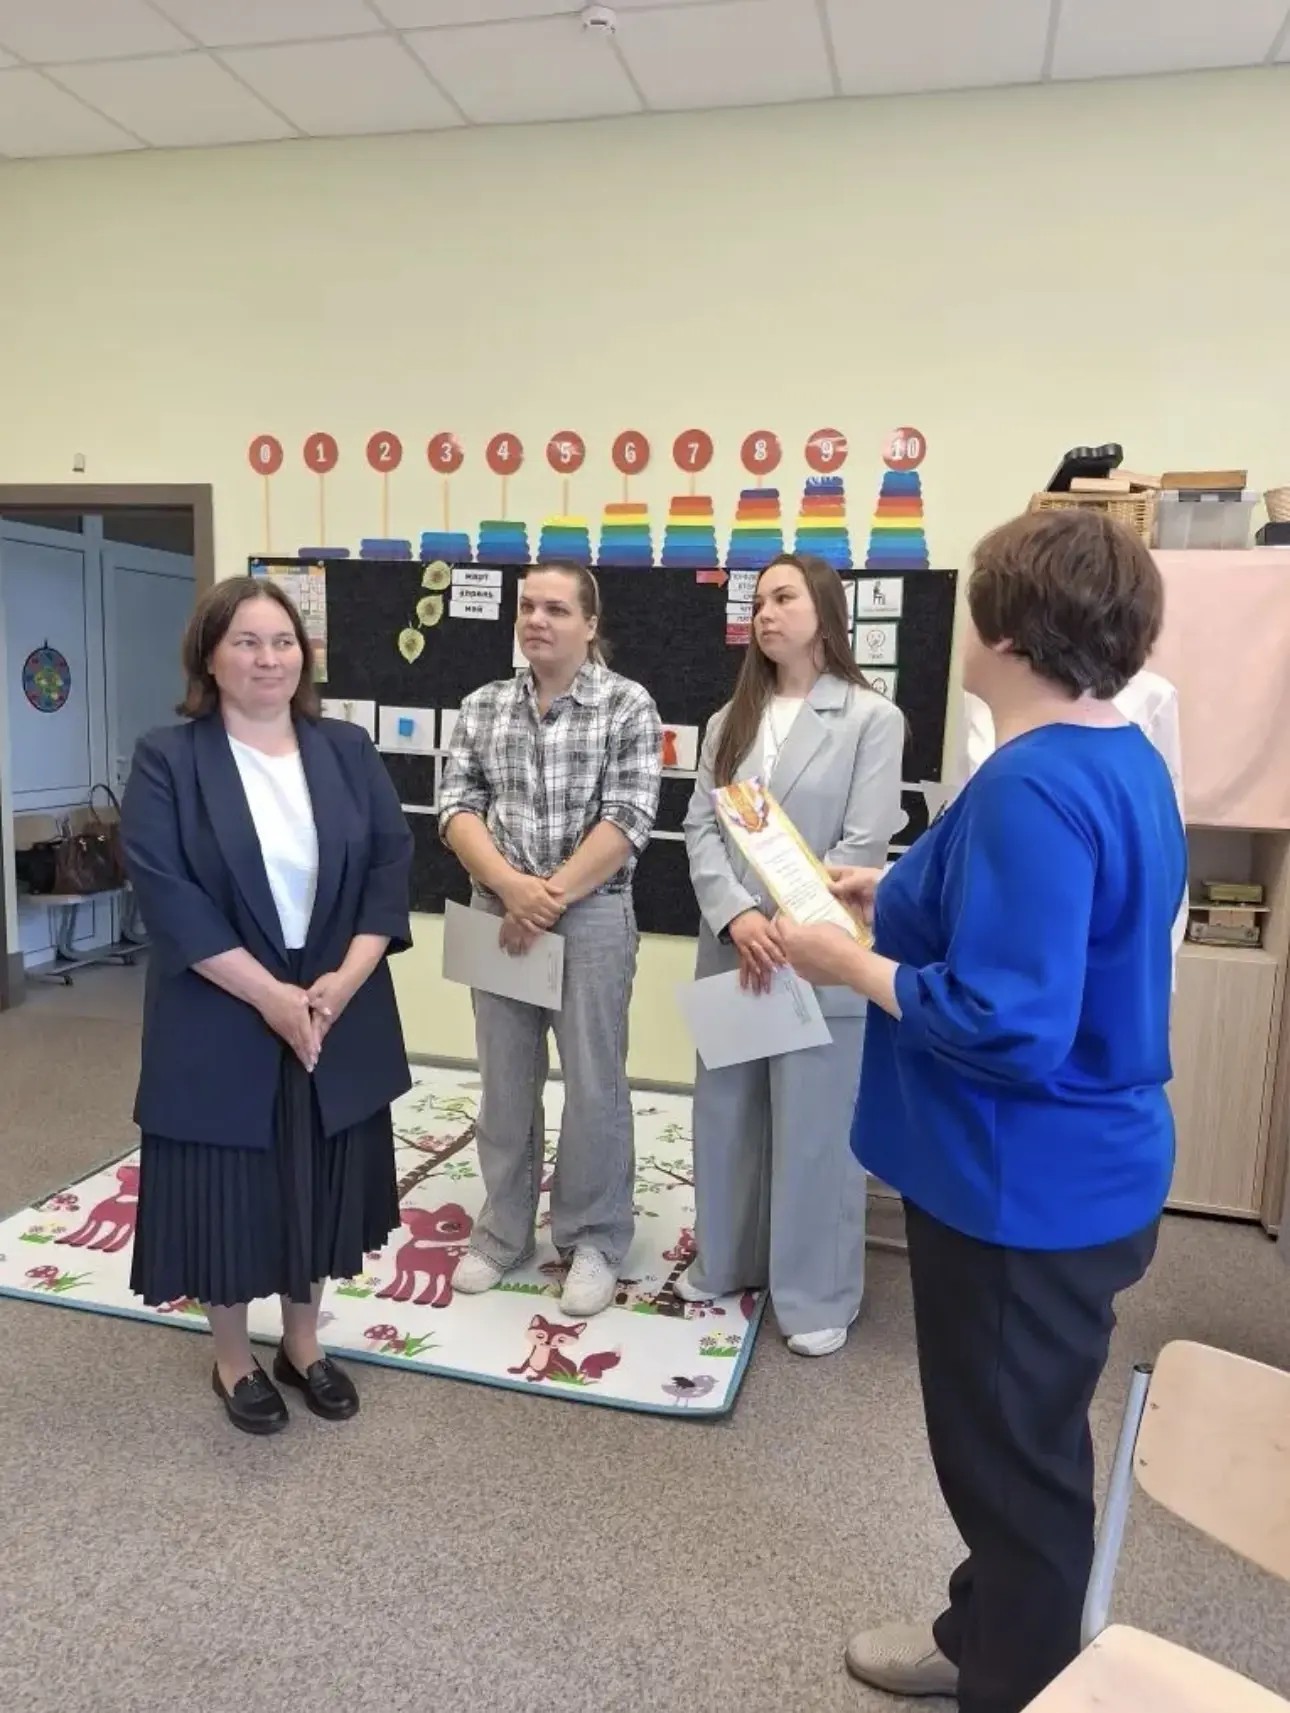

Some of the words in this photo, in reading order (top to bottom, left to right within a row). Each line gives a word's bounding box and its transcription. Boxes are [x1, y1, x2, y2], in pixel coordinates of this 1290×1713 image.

[259, 443, 271, 464] 0
[315, 441, 327, 463] 1
[379, 441, 392, 462] 2
[440, 442, 453, 463] 3
[496, 440, 510, 461] 4
[558, 441, 572, 464] 5
[624, 441, 637, 464] 6
[687, 442, 700, 465] 7
[754, 439, 769, 462] 8
[818, 440, 835, 463] 9
[890, 439, 918, 461] 10
